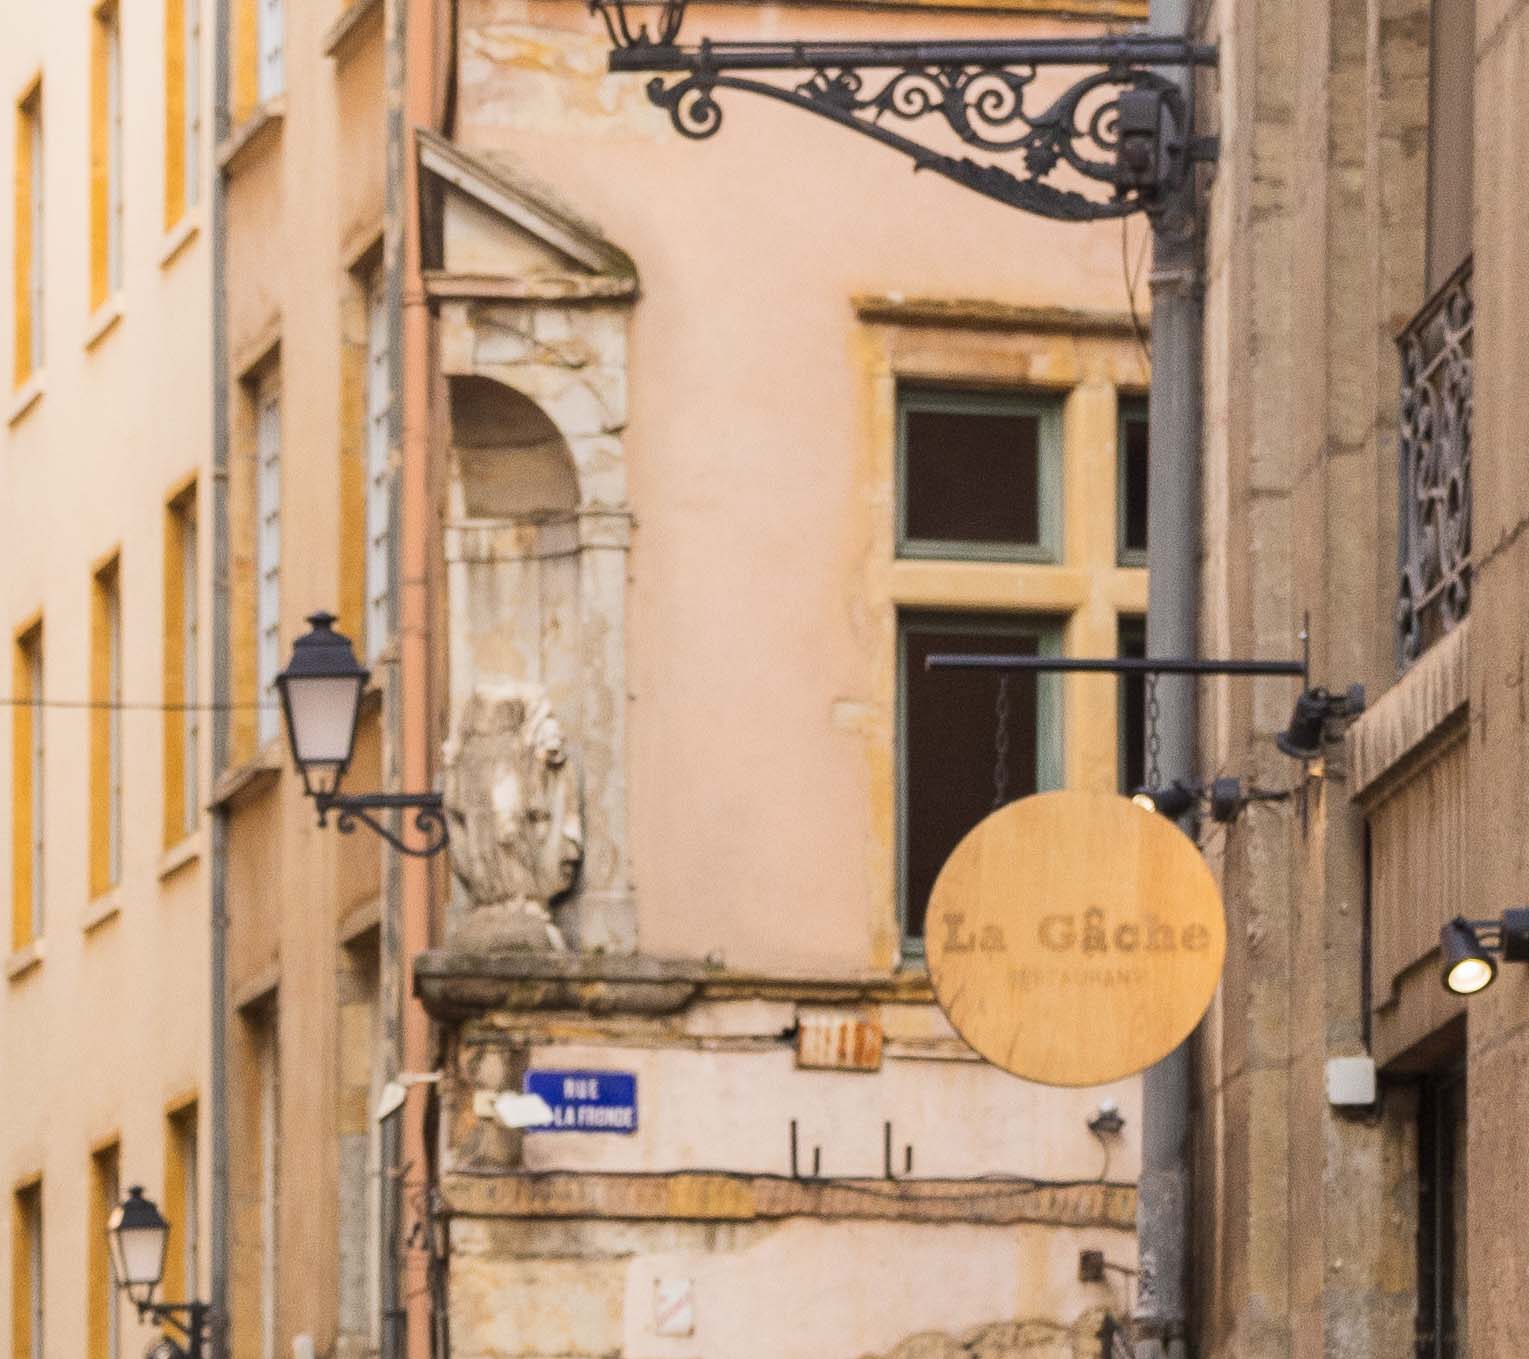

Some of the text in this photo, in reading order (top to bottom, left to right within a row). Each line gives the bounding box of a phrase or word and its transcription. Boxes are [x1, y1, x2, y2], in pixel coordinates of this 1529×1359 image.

[942, 906, 1210, 956] La Gâche
[563, 1078, 600, 1100] RUE
